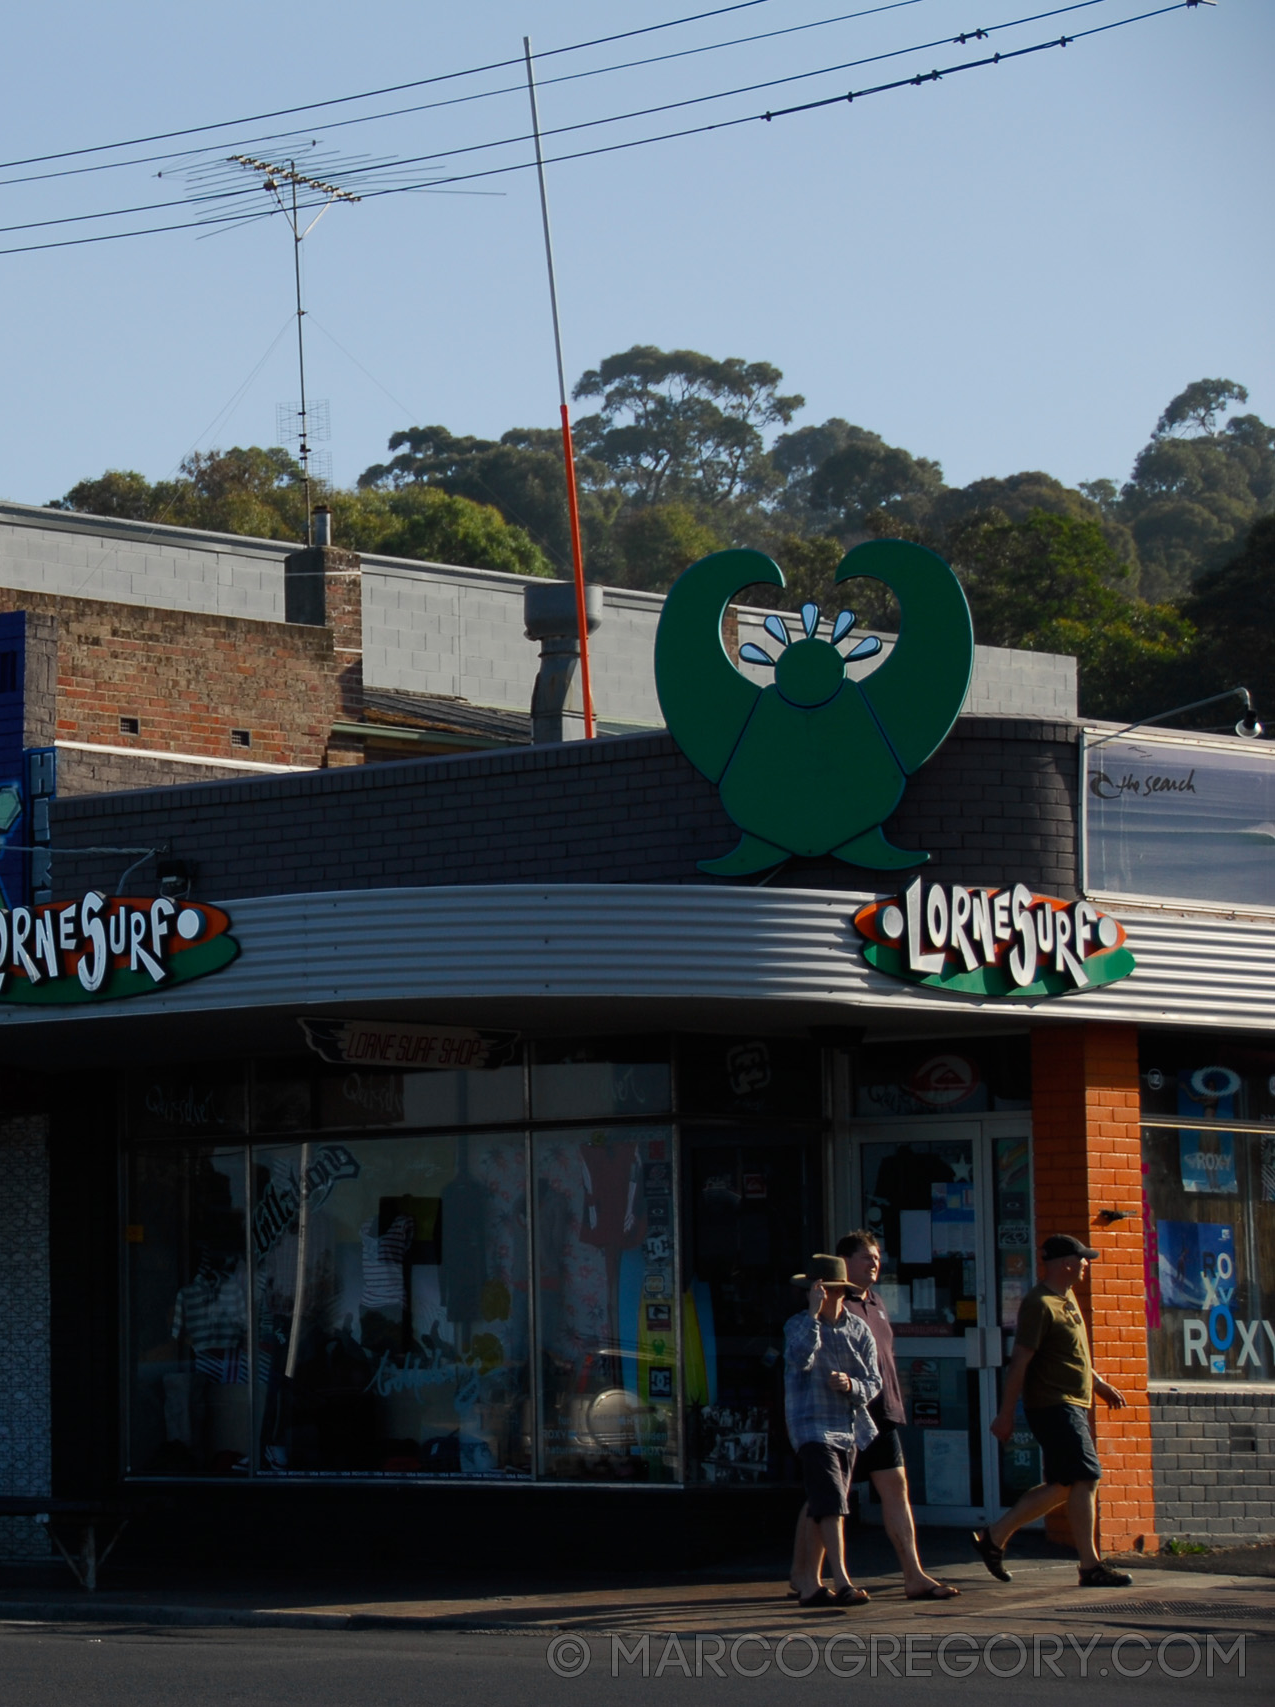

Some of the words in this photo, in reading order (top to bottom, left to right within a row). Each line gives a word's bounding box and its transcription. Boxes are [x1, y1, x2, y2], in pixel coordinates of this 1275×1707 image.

[1143, 769, 1197, 796] search
[347, 1032, 397, 1060] LORNE
[399, 1036, 436, 1063] SURF
[439, 1039, 482, 1066] SHOP
[1195, 1152, 1232, 1172] ROXY
